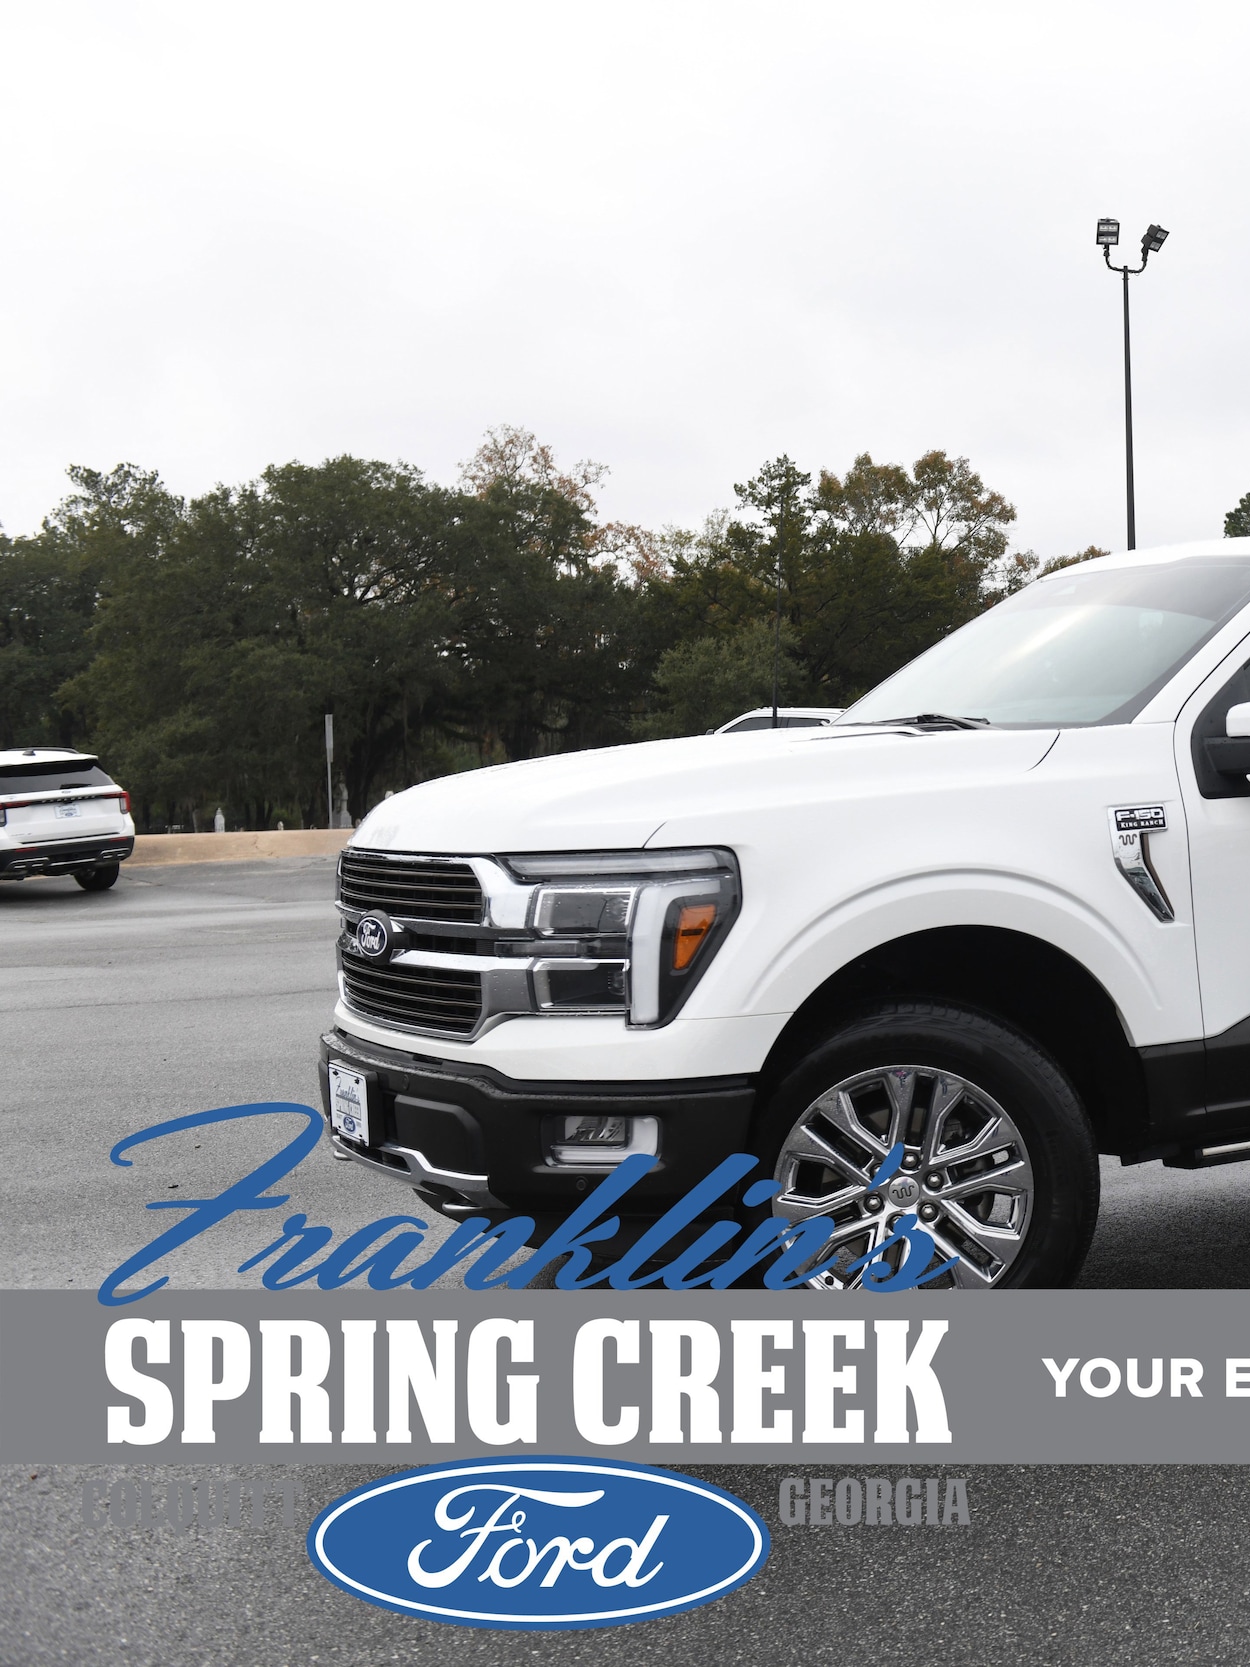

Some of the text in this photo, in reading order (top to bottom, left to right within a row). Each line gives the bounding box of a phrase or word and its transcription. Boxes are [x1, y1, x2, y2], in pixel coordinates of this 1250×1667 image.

[1116, 808, 1164, 821] F-150
[1140, 819, 1164, 827] RANCH
[361, 921, 381, 950] Ford
